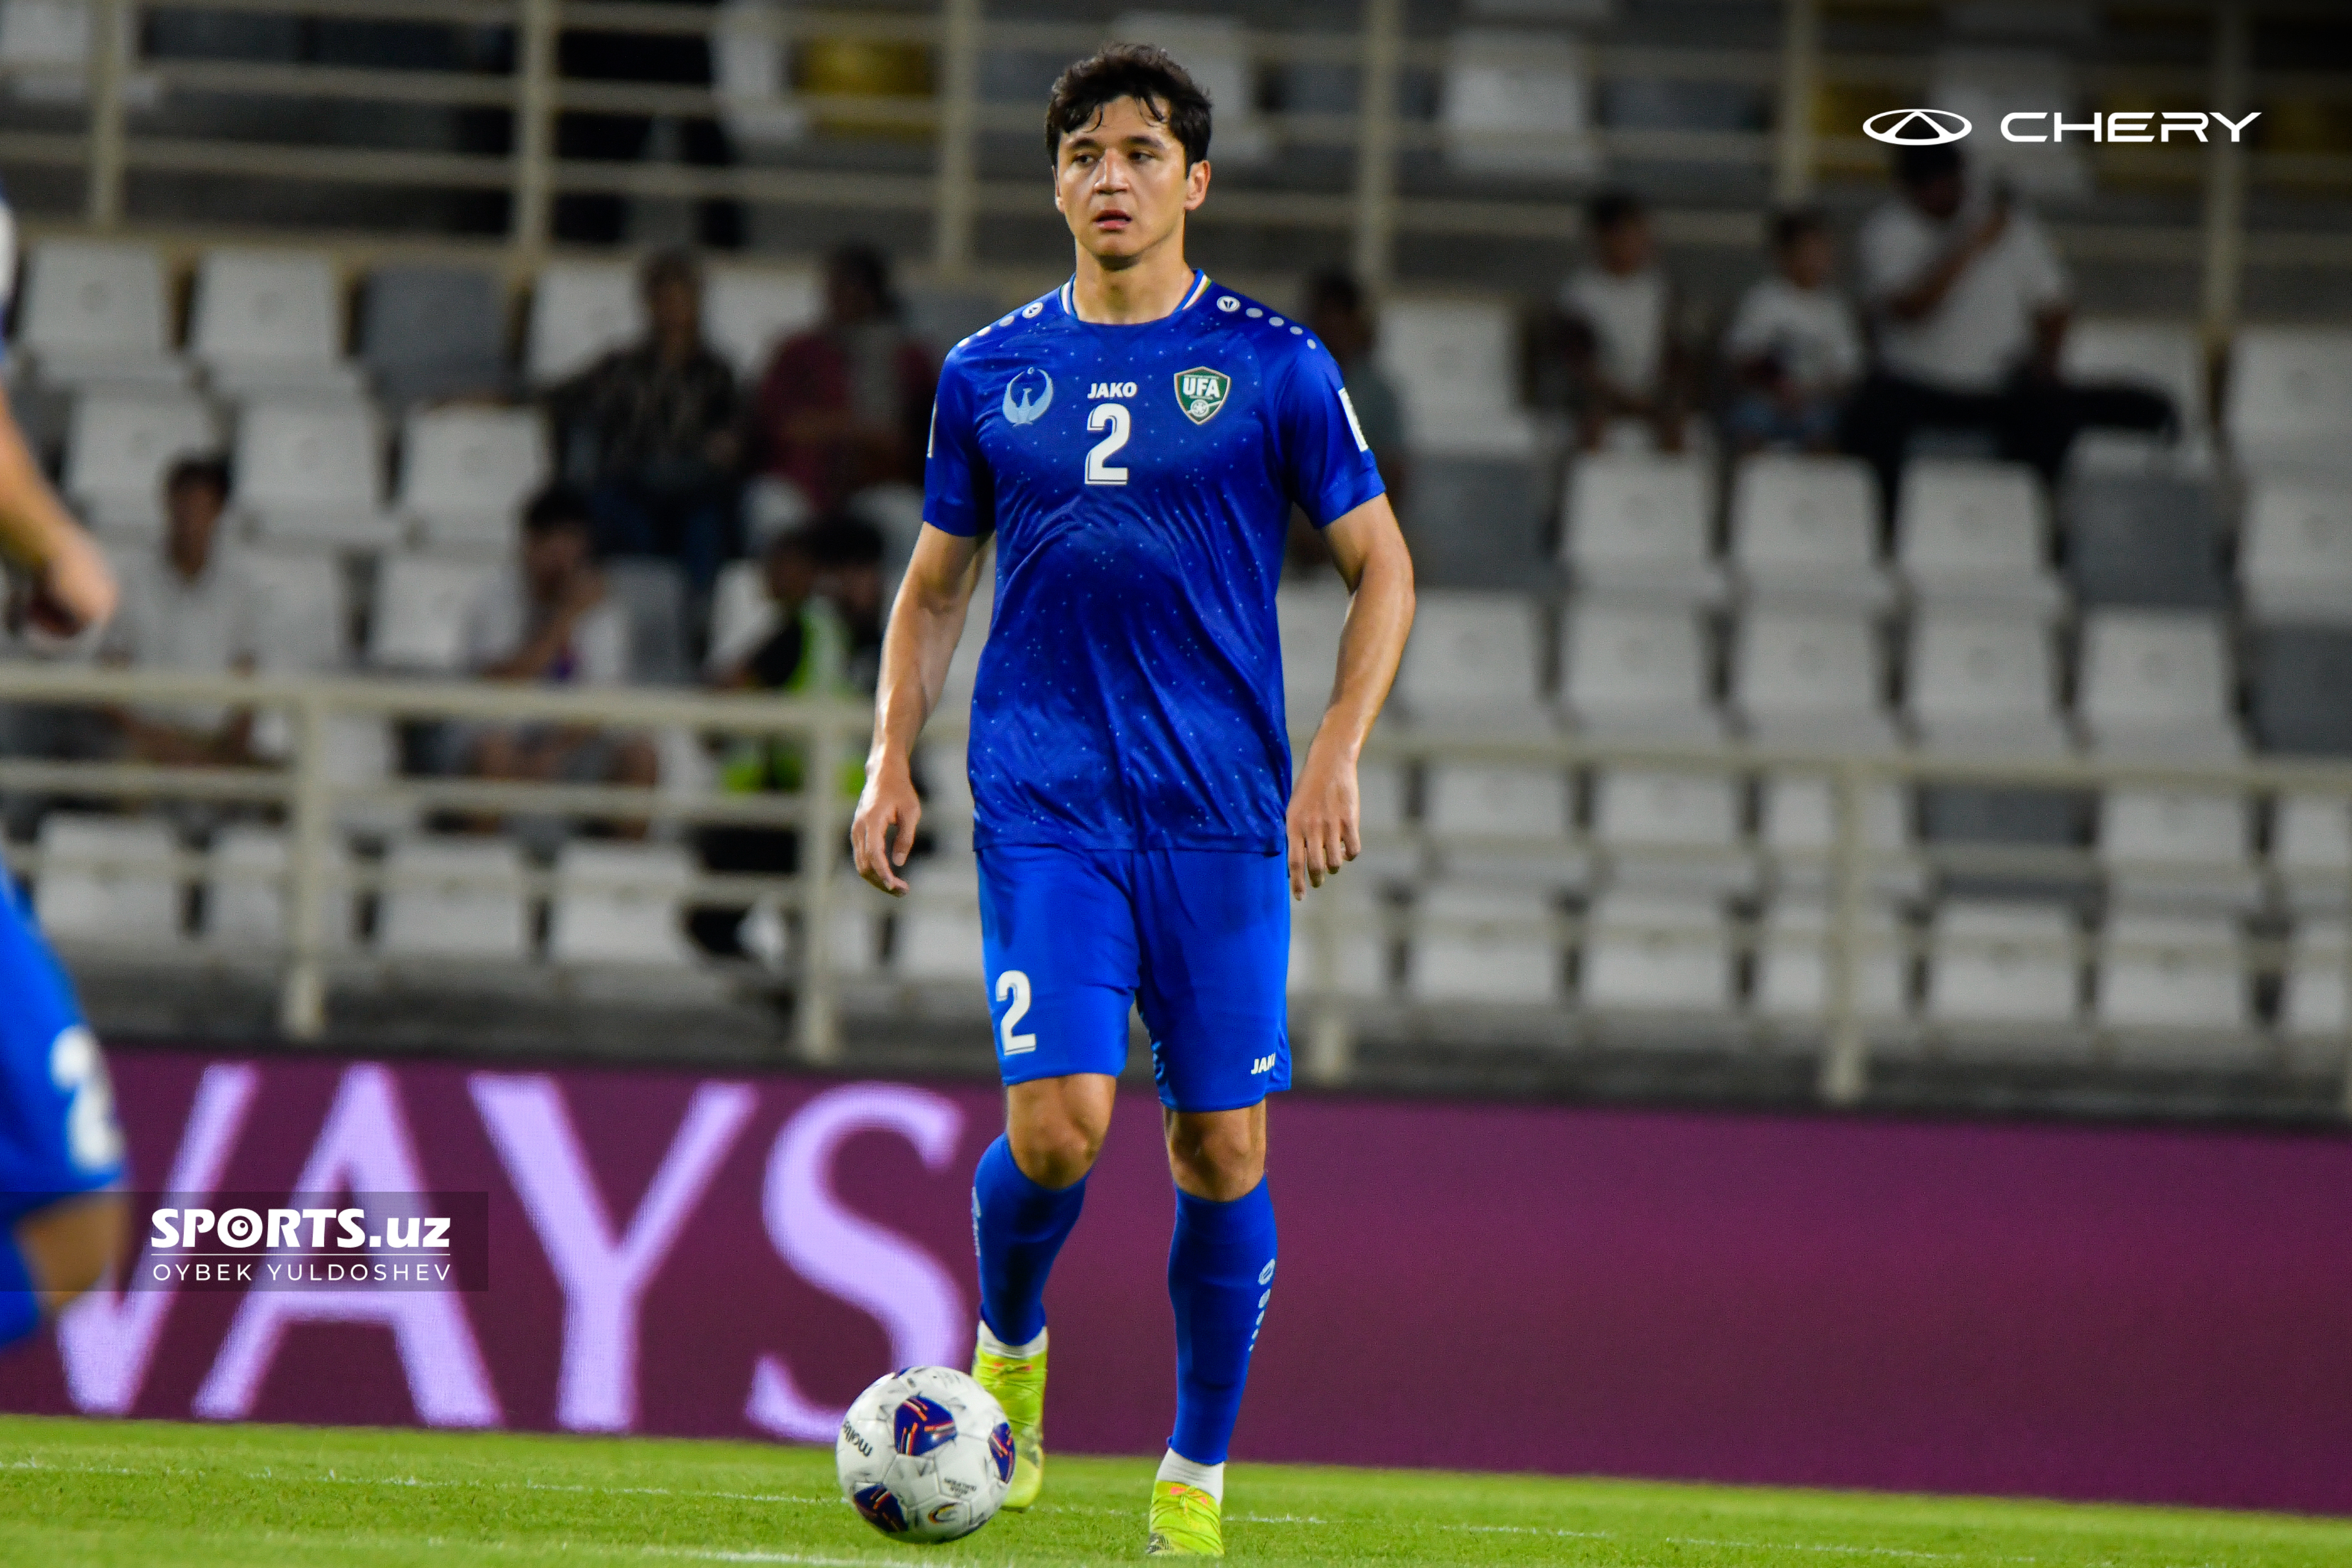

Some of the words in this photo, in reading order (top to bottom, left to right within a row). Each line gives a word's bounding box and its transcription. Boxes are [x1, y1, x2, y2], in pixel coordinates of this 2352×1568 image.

[1087, 381, 1137, 399] JAKO
[1183, 378, 1220, 398] UFA
[1084, 403, 1131, 485] 2
[995, 970, 1037, 1056] 2
[1250, 1052, 1276, 1075] JAK
